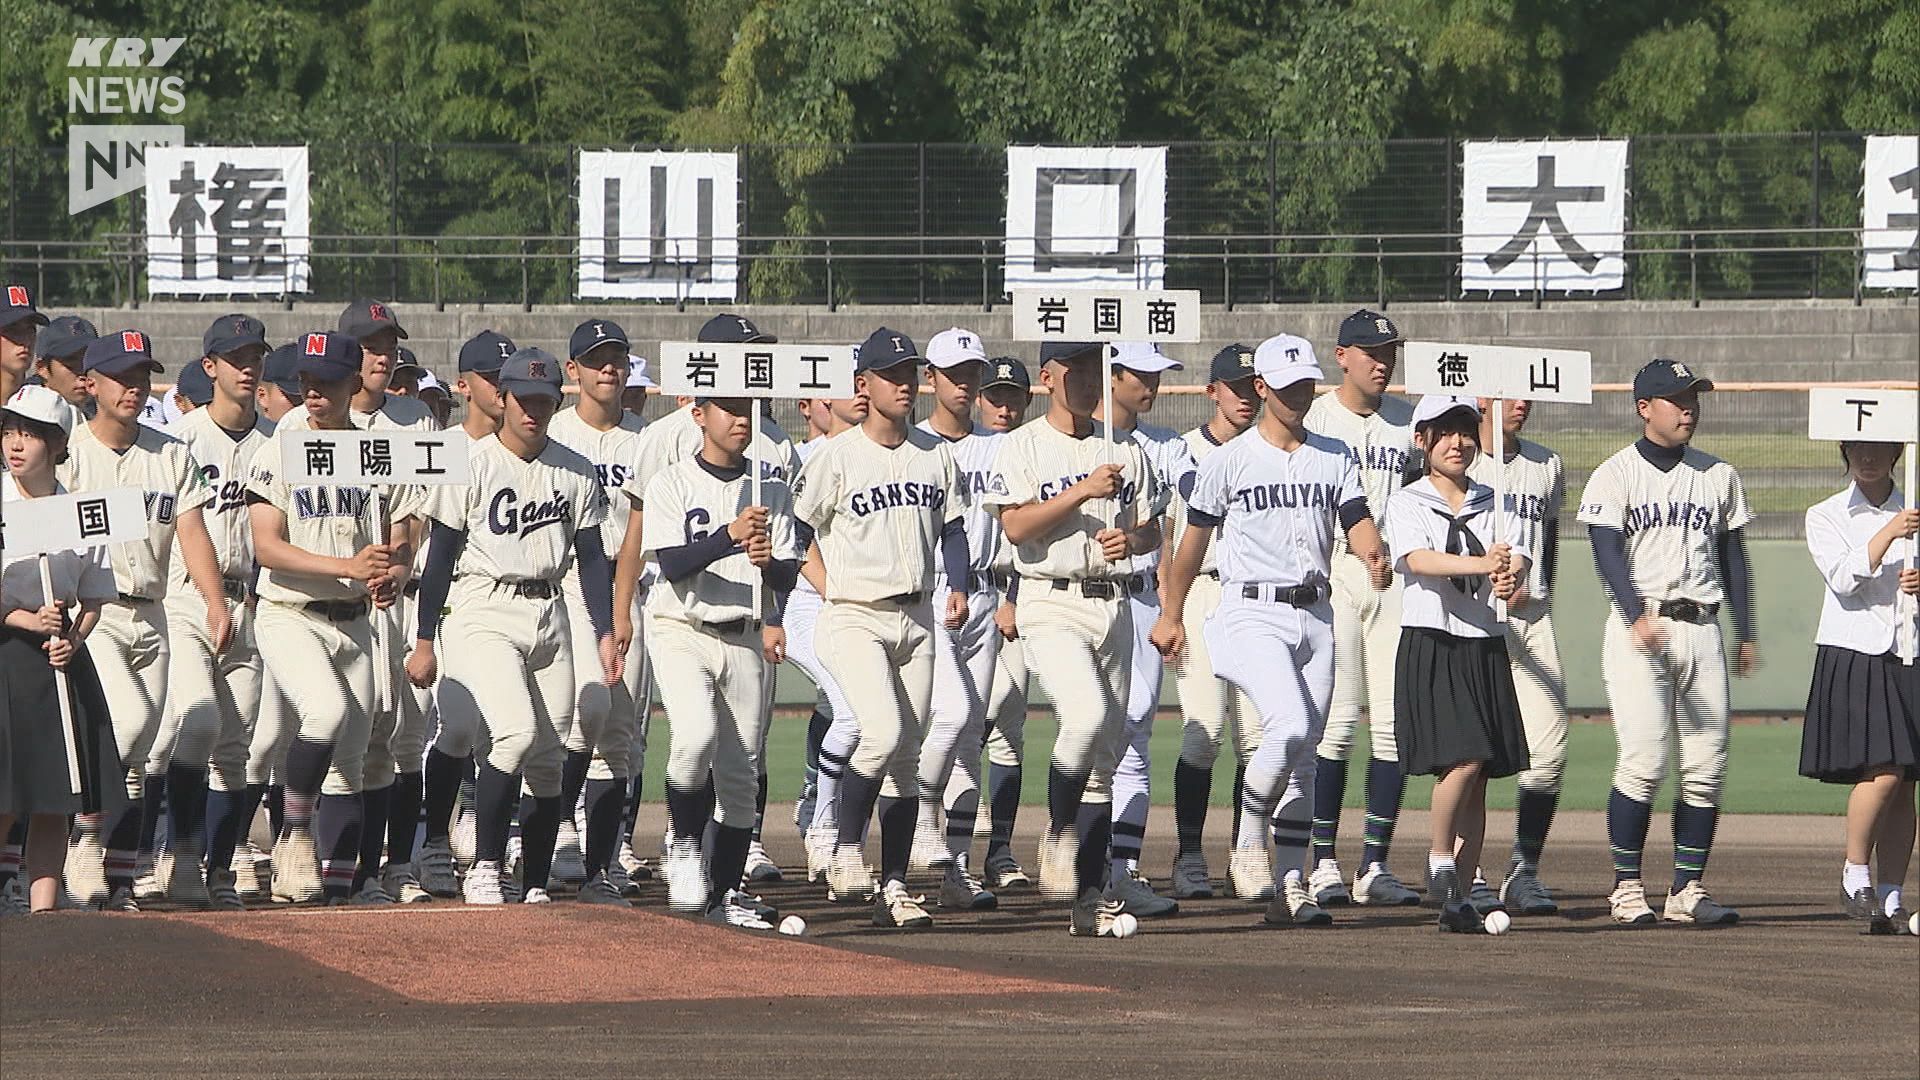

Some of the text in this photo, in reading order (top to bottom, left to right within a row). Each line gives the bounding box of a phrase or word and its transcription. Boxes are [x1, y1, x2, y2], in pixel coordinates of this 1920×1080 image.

[169, 160, 288, 281] 権
[604, 166, 713, 283] 山
[1034, 167, 1137, 273] 口
[1484, 155, 1605, 274] 大
[7, 286, 30, 307] N
[1037, 297, 1177, 335] 岩国商
[122, 331, 145, 352] N
[306, 334, 328, 356] N
[1285, 347, 1300, 362] T
[686, 351, 831, 390] 岩国工
[1437, 352, 1560, 393] 徳山
[1846, 399, 1878, 431] 下
[305, 439, 446, 477] 南陽工
[851, 482, 945, 517] GANSHO
